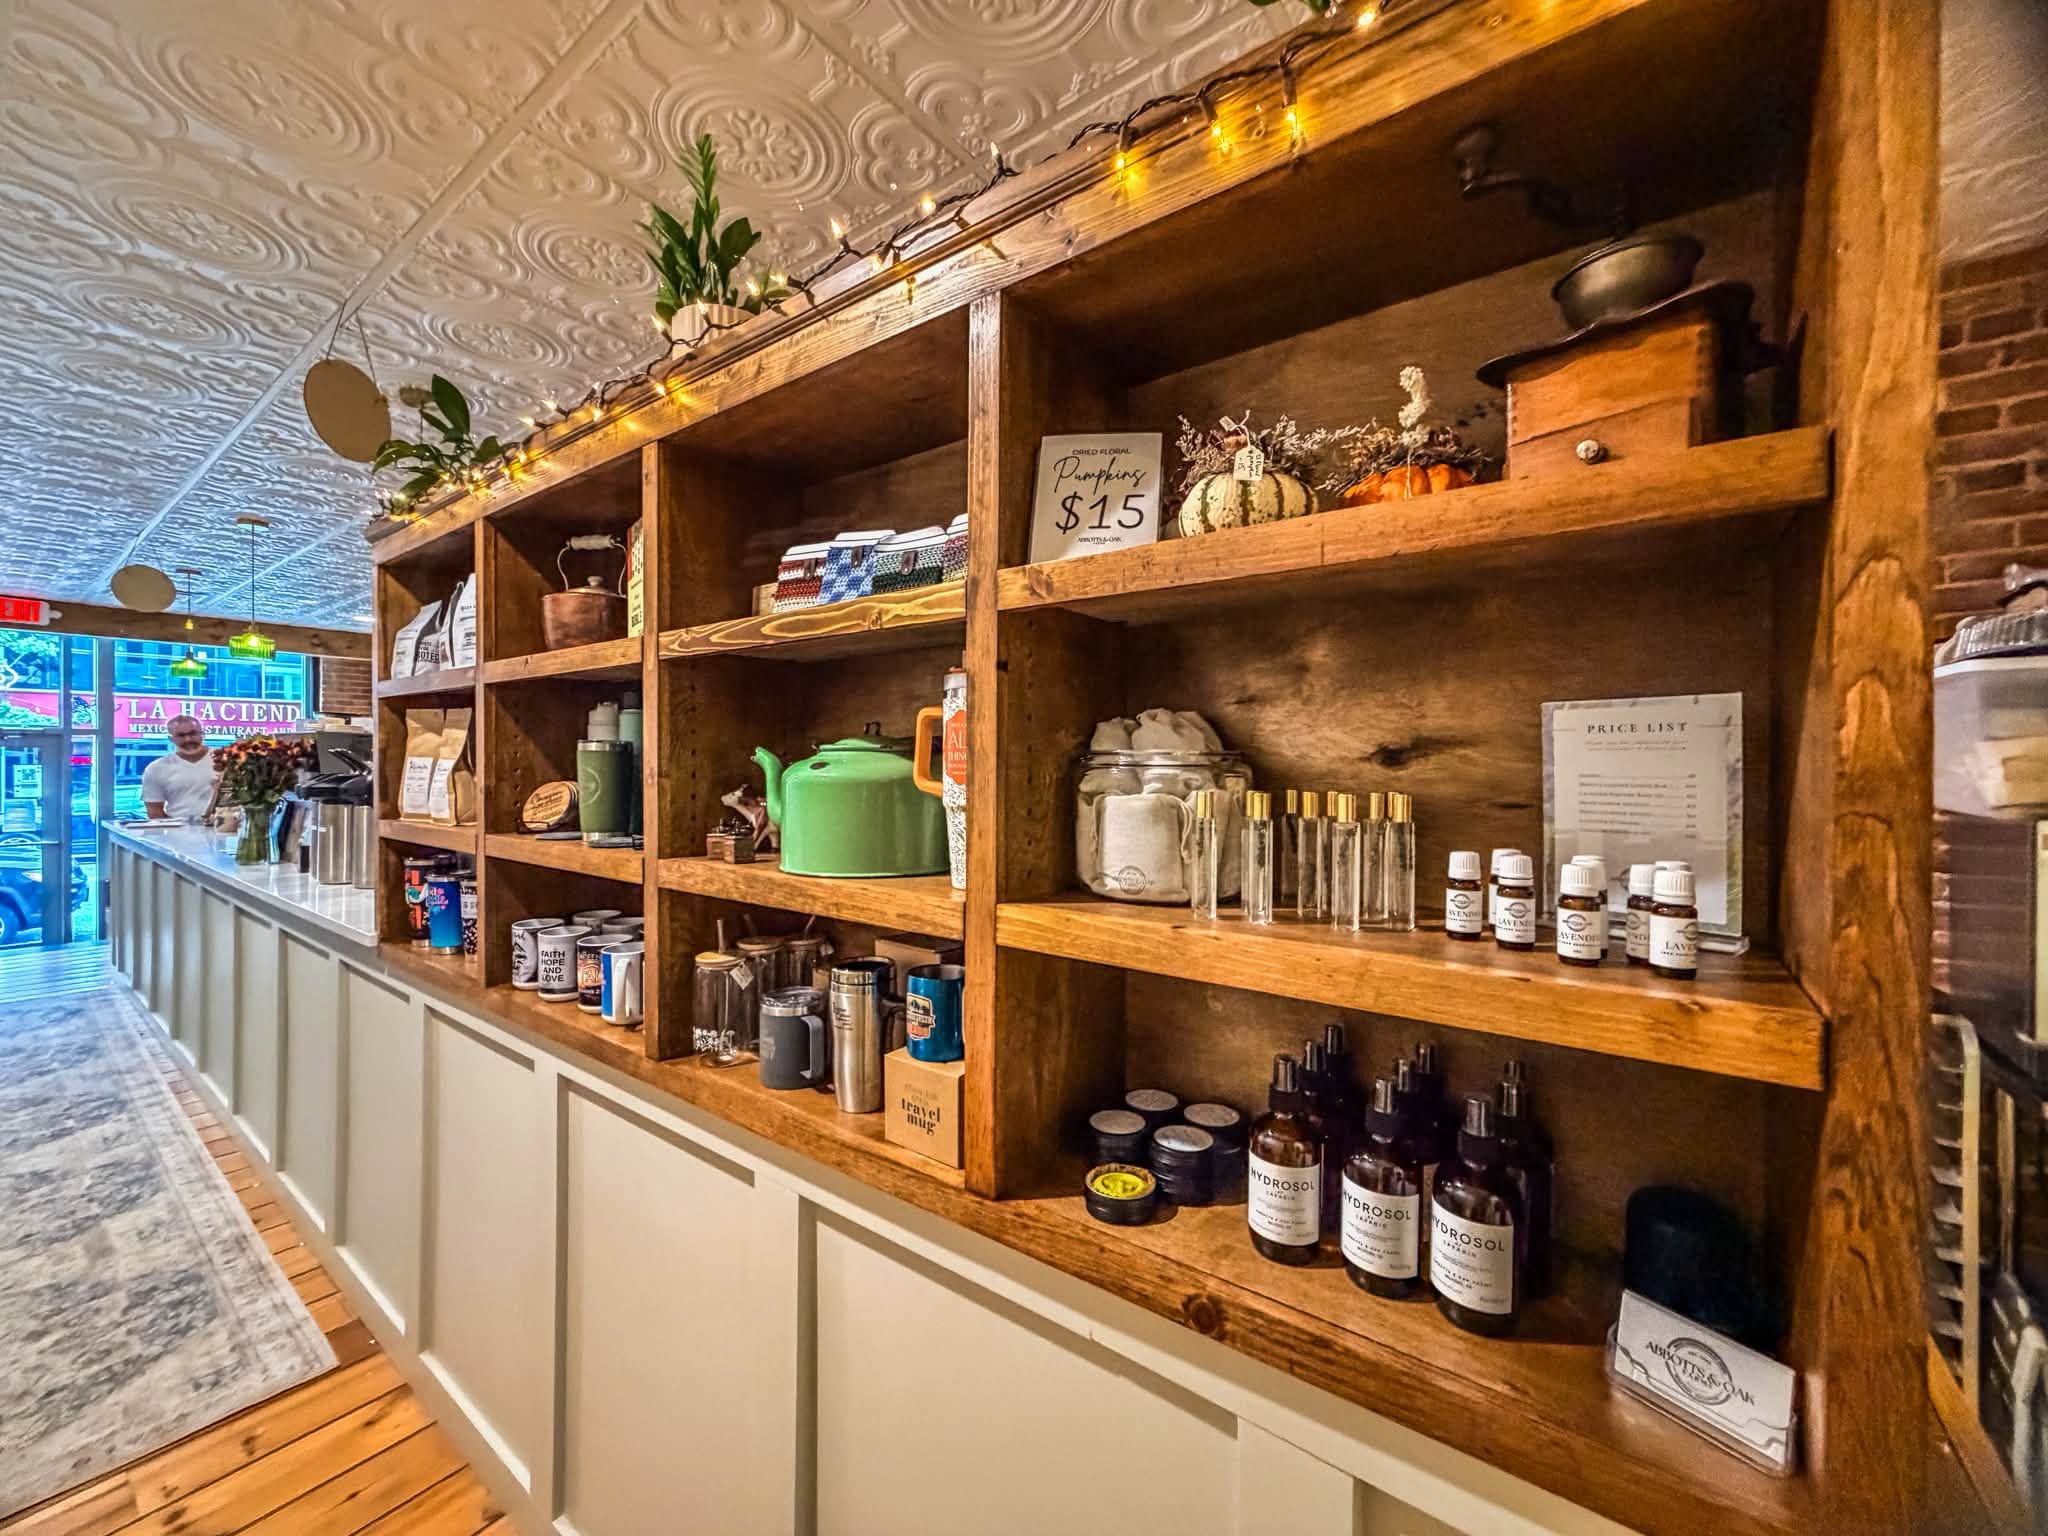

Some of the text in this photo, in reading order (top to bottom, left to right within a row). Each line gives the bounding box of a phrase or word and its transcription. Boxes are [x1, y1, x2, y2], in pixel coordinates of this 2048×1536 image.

[1072, 447, 1131, 456] DRIED FLORAL
[1053, 455, 1147, 496] Pumpkins
[1055, 491, 1146, 535] $15
[128, 700, 167, 719] LA
[128, 724, 168, 733] MEXIC
[204, 725, 269, 737] STAURANT
[1587, 722, 1688, 734] PRICE LIST
[949, 728, 968, 749] AL
[541, 950, 565, 958] FAITH
[541, 958, 565, 966] HOPE
[542, 974, 564, 982] LOVE
[543, 966, 562, 974] AND
[902, 1097, 940, 1123] travel
[907, 1112, 936, 1136] mug
[1251, 1166, 1315, 1192] HYDROSOL
[1343, 1190, 1411, 1221] HYDROSOL
[1646, 1341, 1705, 1378] ABBOTTS
[1723, 1381, 1754, 1406] OAK
